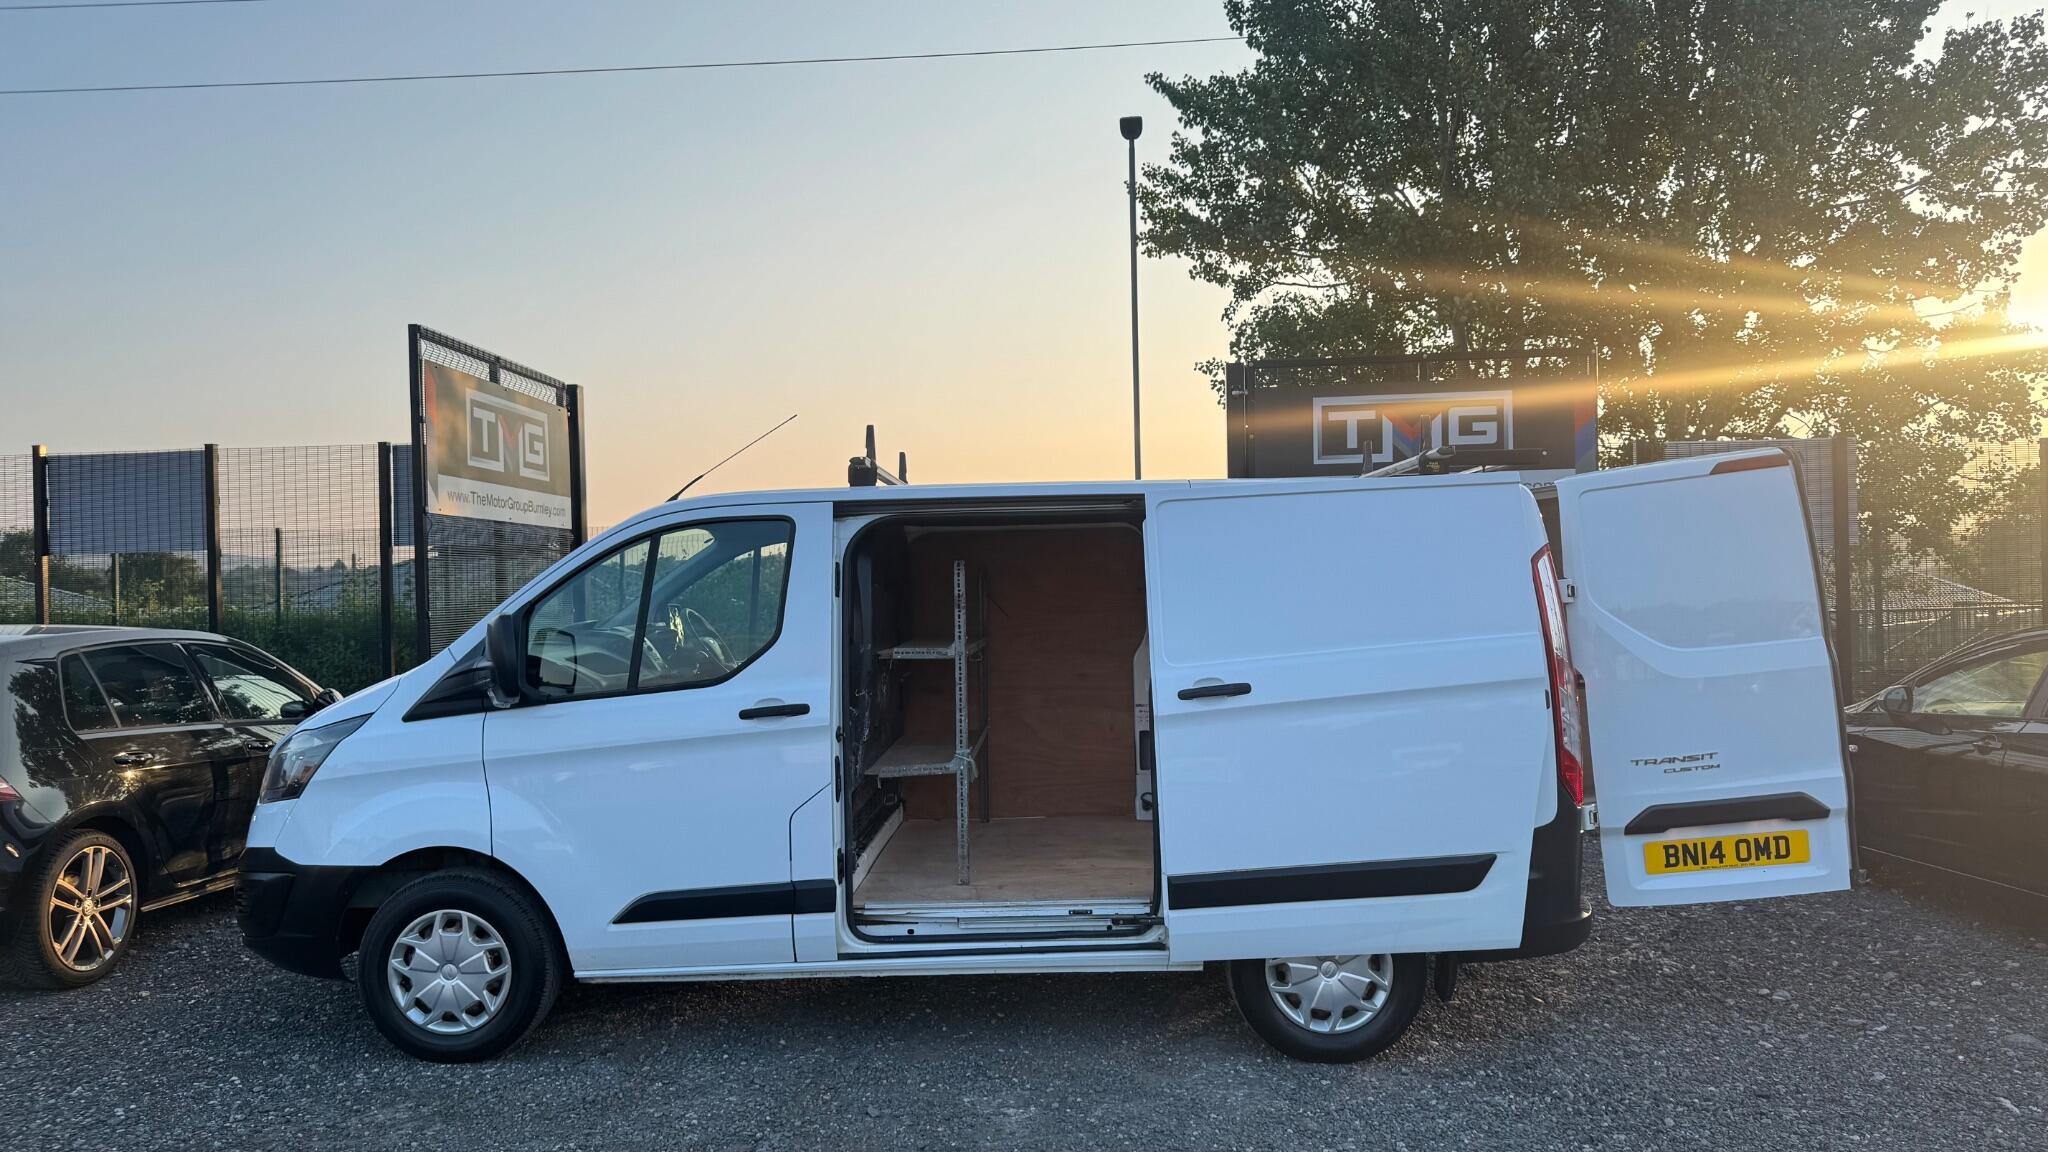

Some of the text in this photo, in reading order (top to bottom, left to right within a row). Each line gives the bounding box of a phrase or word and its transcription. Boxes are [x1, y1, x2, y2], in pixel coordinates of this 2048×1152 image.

[447, 490, 566, 517] www.TheMotorGroupBurnley.com
[1630, 752, 1718, 767] TRANSIT
[1664, 764, 1720, 774] CUSTOM
[1663, 835, 1791, 869] BN14 OMD
